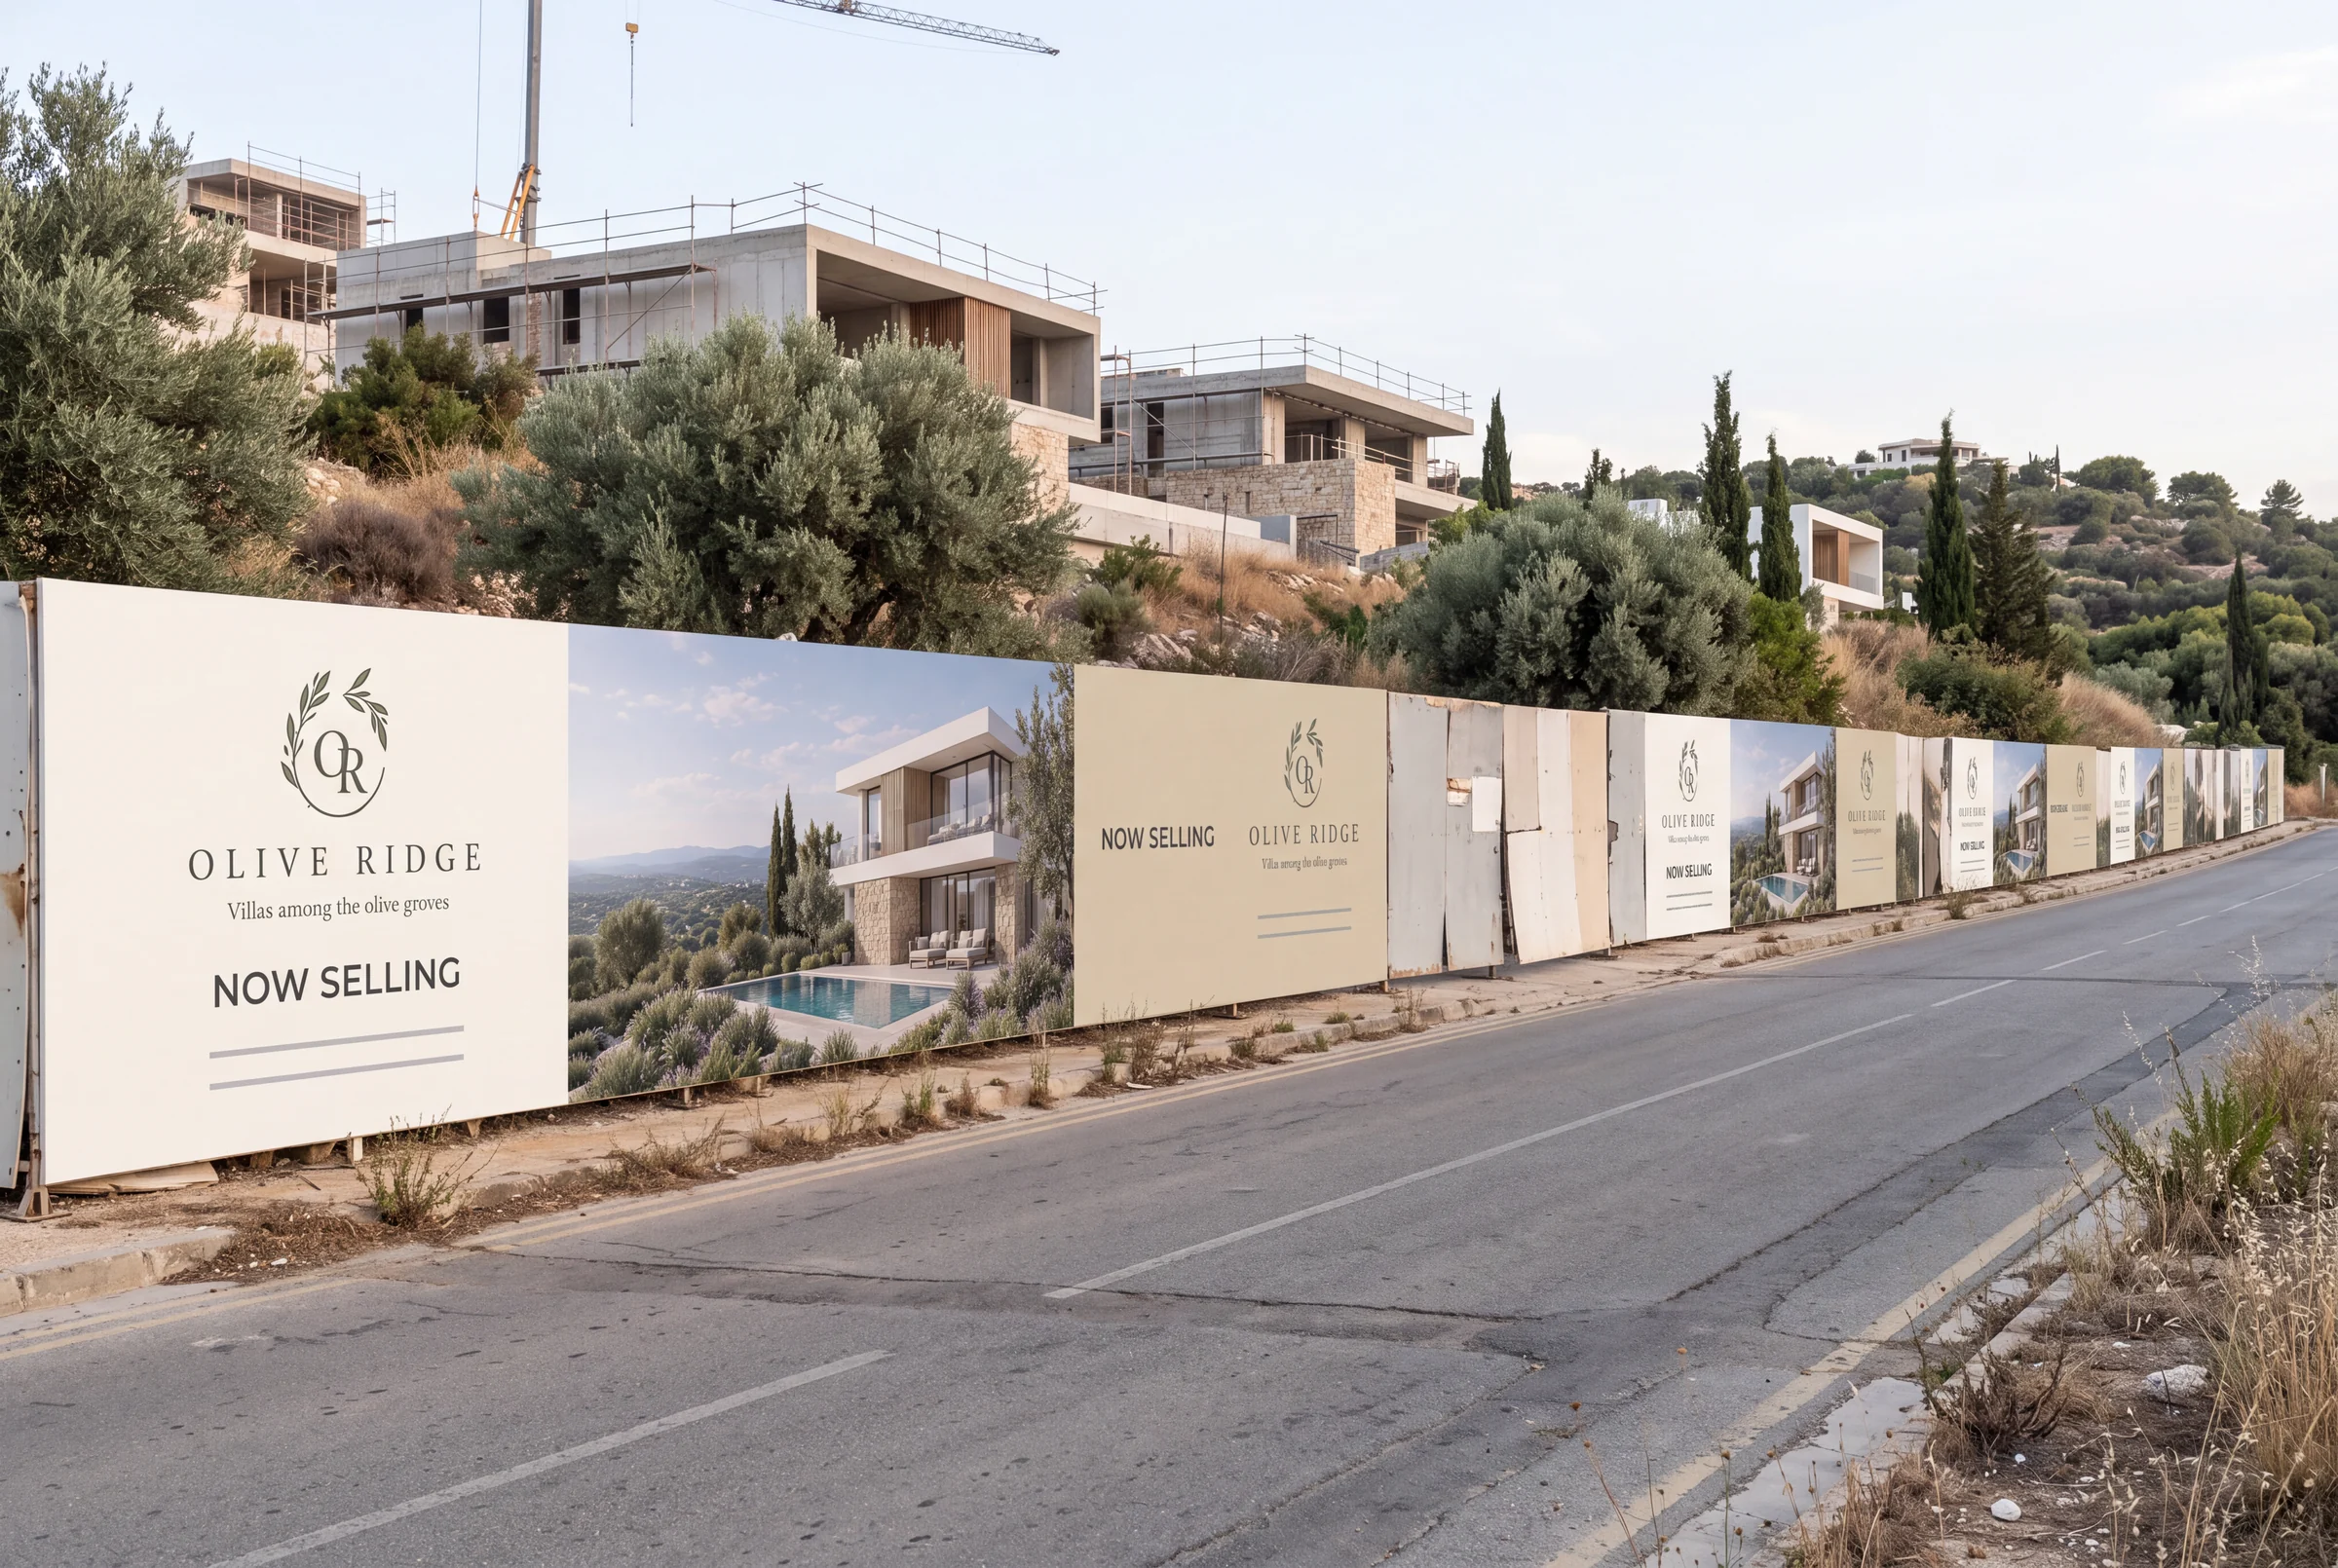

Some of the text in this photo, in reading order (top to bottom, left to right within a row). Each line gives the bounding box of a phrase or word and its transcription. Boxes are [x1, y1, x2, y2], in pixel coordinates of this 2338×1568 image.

[314, 729, 368, 795] OR
[1102, 825, 1215, 850] NOW SELLING
[1249, 823, 1360, 846] OLIVE RIDGE
[189, 842, 482, 881] OLIVE RIDGE
[1666, 863, 1713, 879] NOW SELLING
[227, 894, 450, 922] Villas among the olive groves
[214, 956, 461, 1008] NOW SELLING
